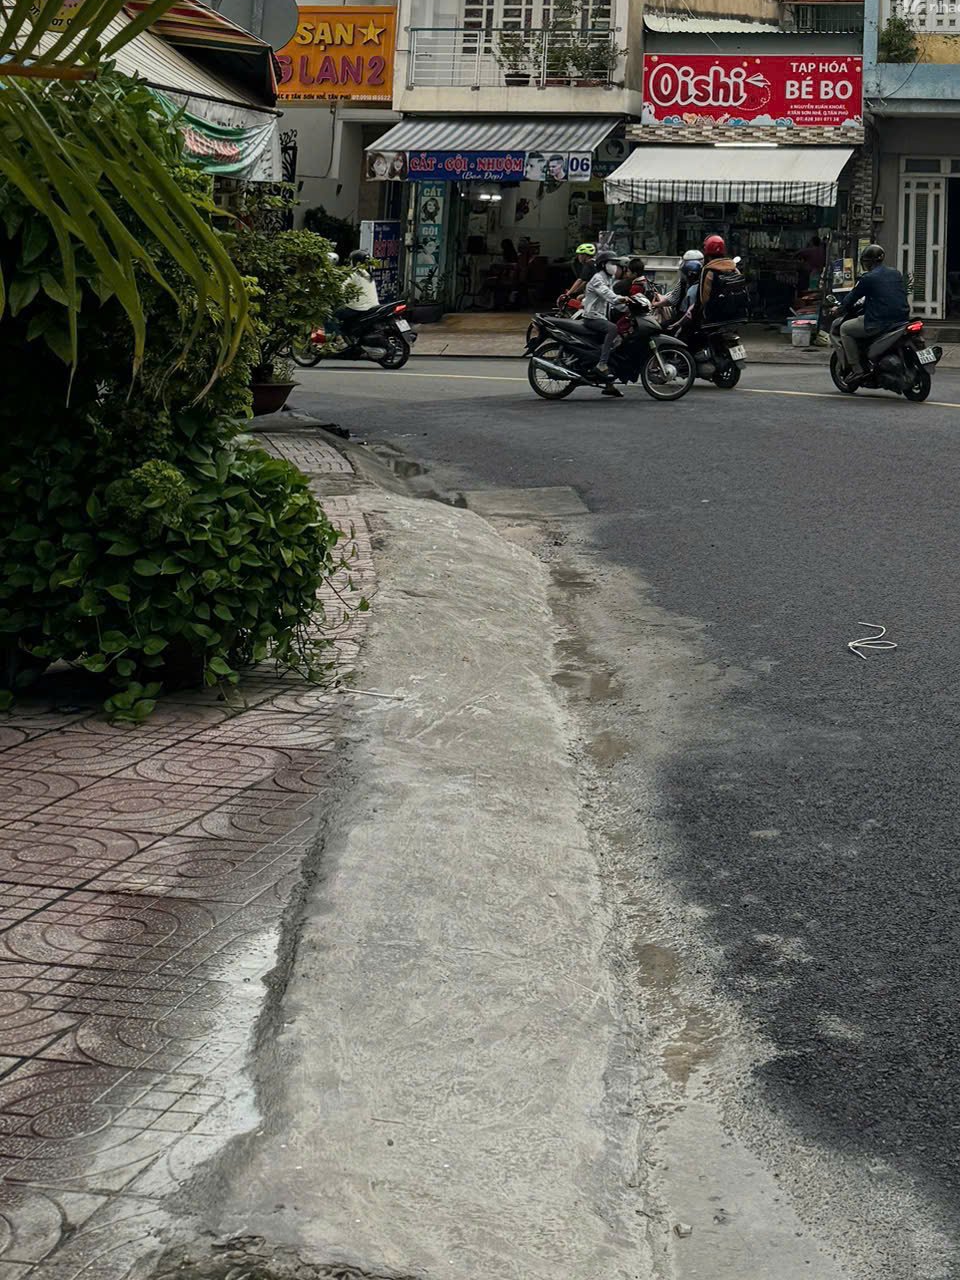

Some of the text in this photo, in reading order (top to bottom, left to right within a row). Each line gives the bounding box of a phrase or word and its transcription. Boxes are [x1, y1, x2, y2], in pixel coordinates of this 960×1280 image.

[295, 22, 355, 51] SẠN
[300, 55, 364, 85] LAN
[367, 55, 386, 85] 2
[790, 60, 848, 76] TẠP HÓA
[649, 63, 747, 107] Oishi
[785, 76, 853, 100] BÉ BO
[410, 153, 523, 174] CẮT GỘI NHUỘM
[570, 157, 590, 172] 06
